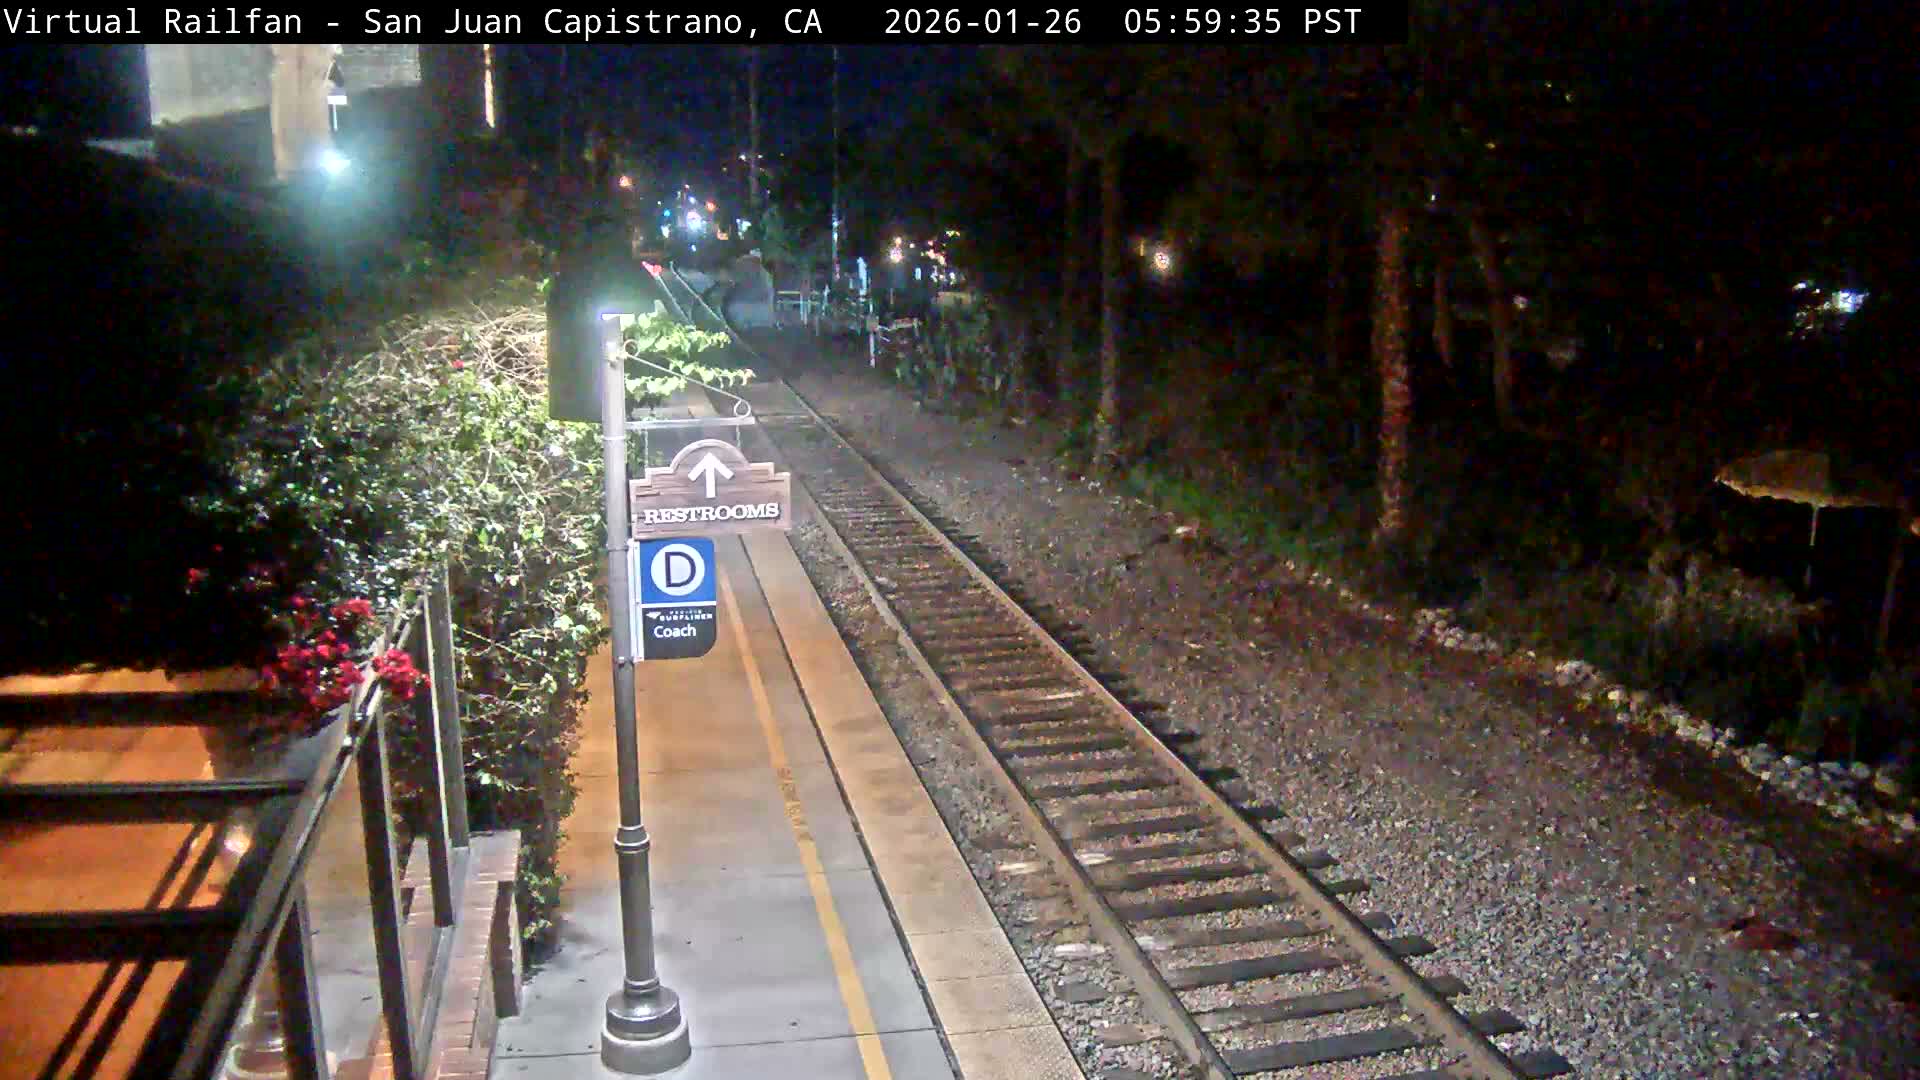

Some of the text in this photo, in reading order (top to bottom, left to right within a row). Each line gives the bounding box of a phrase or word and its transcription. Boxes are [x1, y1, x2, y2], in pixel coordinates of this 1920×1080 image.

[643, 502, 780, 525] RESTROOMS
[664, 551, 697, 588] D
[653, 623, 697, 638] Coach
